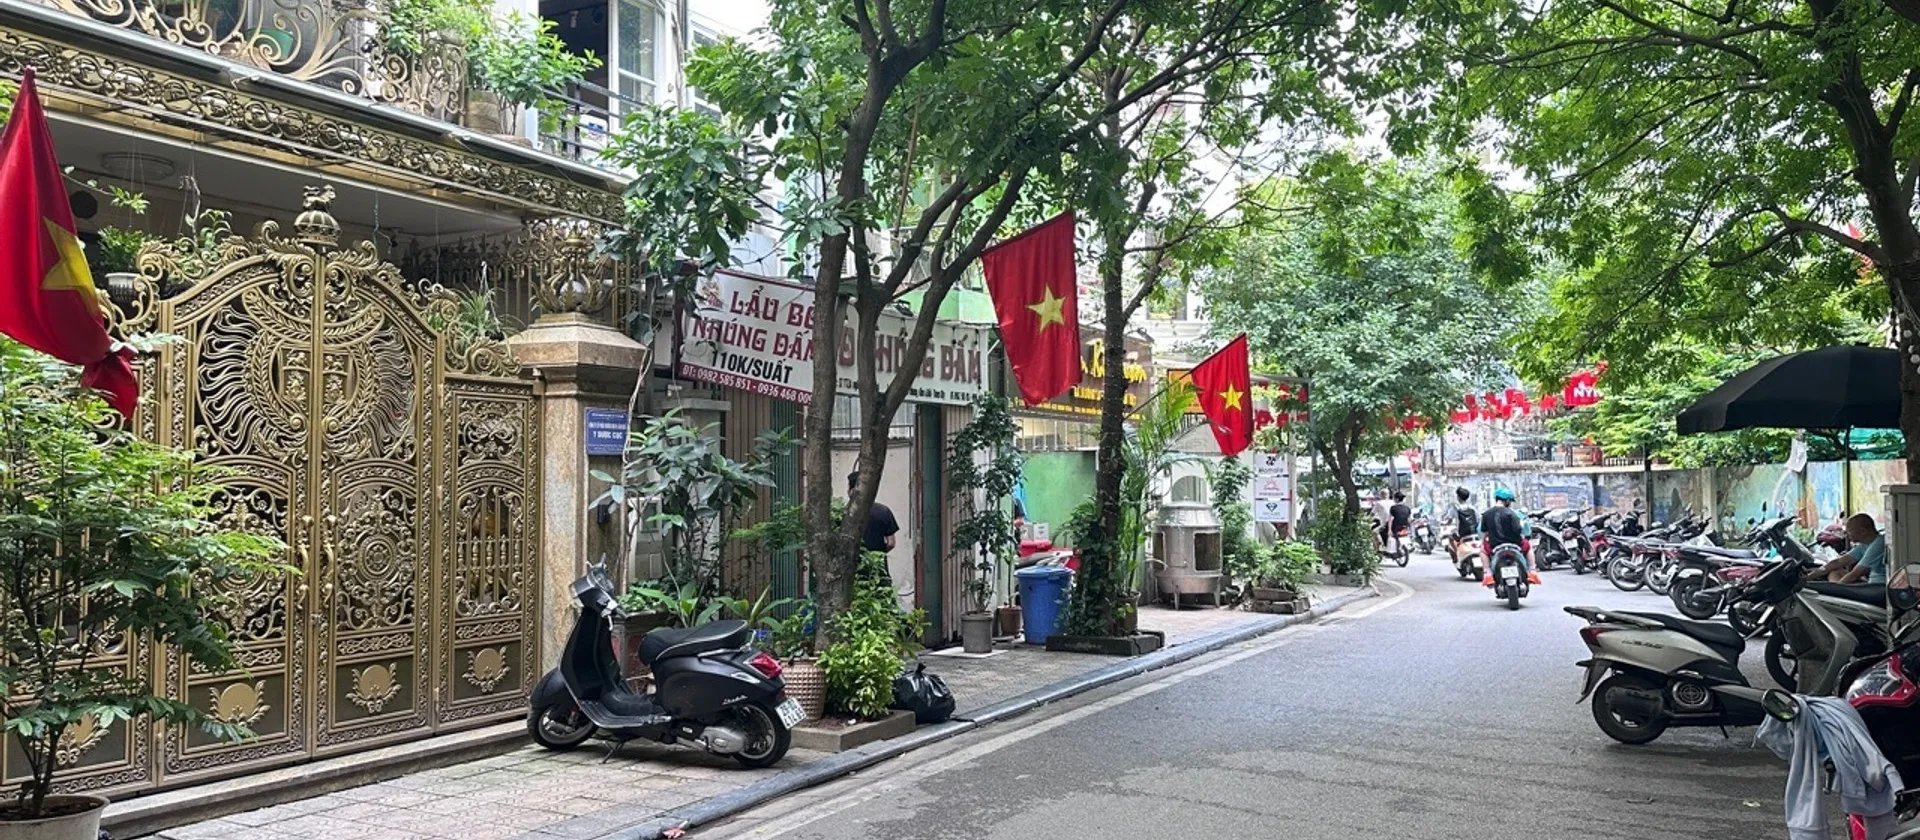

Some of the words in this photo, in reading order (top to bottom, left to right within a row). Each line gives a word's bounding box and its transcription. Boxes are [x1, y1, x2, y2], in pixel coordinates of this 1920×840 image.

[730, 285, 779, 322] LẨU
[692, 317, 767, 352] NHÚNG
[697, 368, 718, 382] 0982
[719, 373, 735, 387] 585
[735, 377, 751, 390] 851
[757, 382, 779, 397] 0936
[711, 349, 792, 385] 110K/SUẤT
